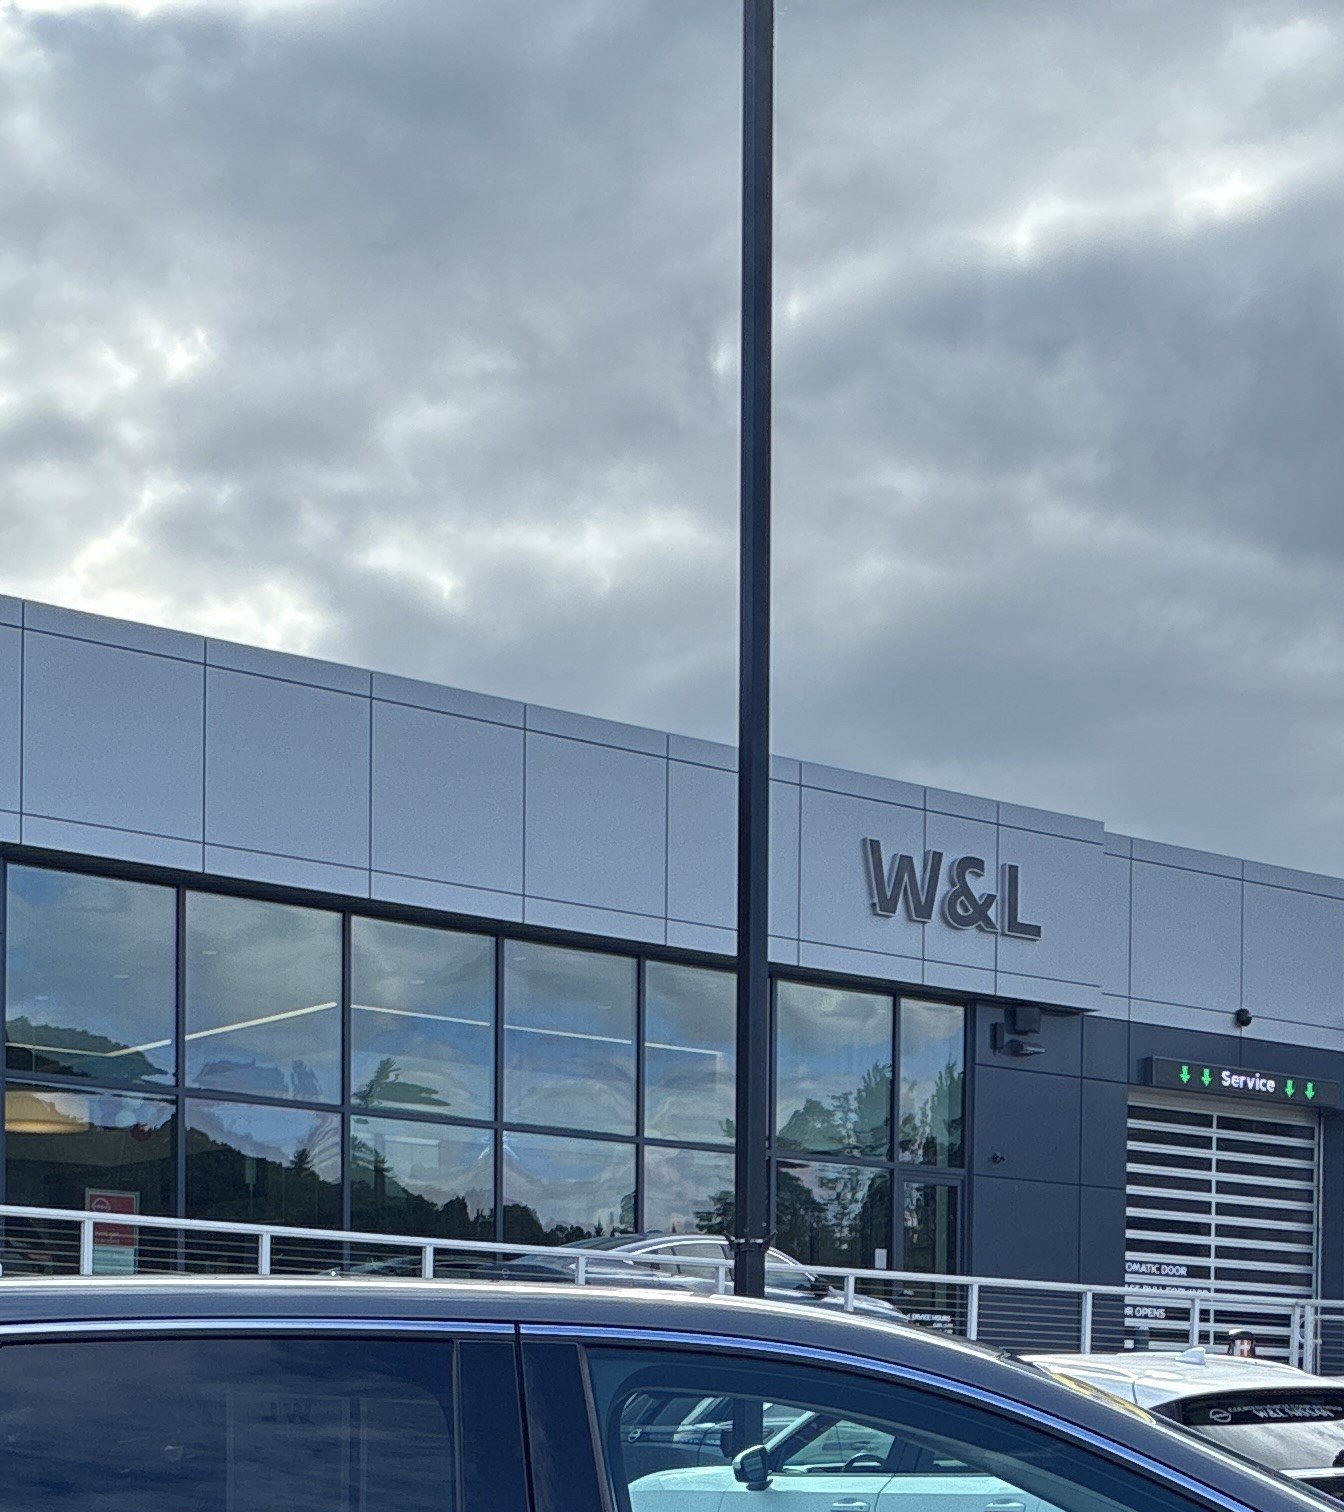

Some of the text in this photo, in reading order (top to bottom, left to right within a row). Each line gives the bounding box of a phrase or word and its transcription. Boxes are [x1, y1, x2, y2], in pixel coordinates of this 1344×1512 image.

[860, 837, 1042, 942] W&L
[1220, 1070, 1276, 1093] Service
[1125, 1261, 1188, 1277] OMATIC DOOR
